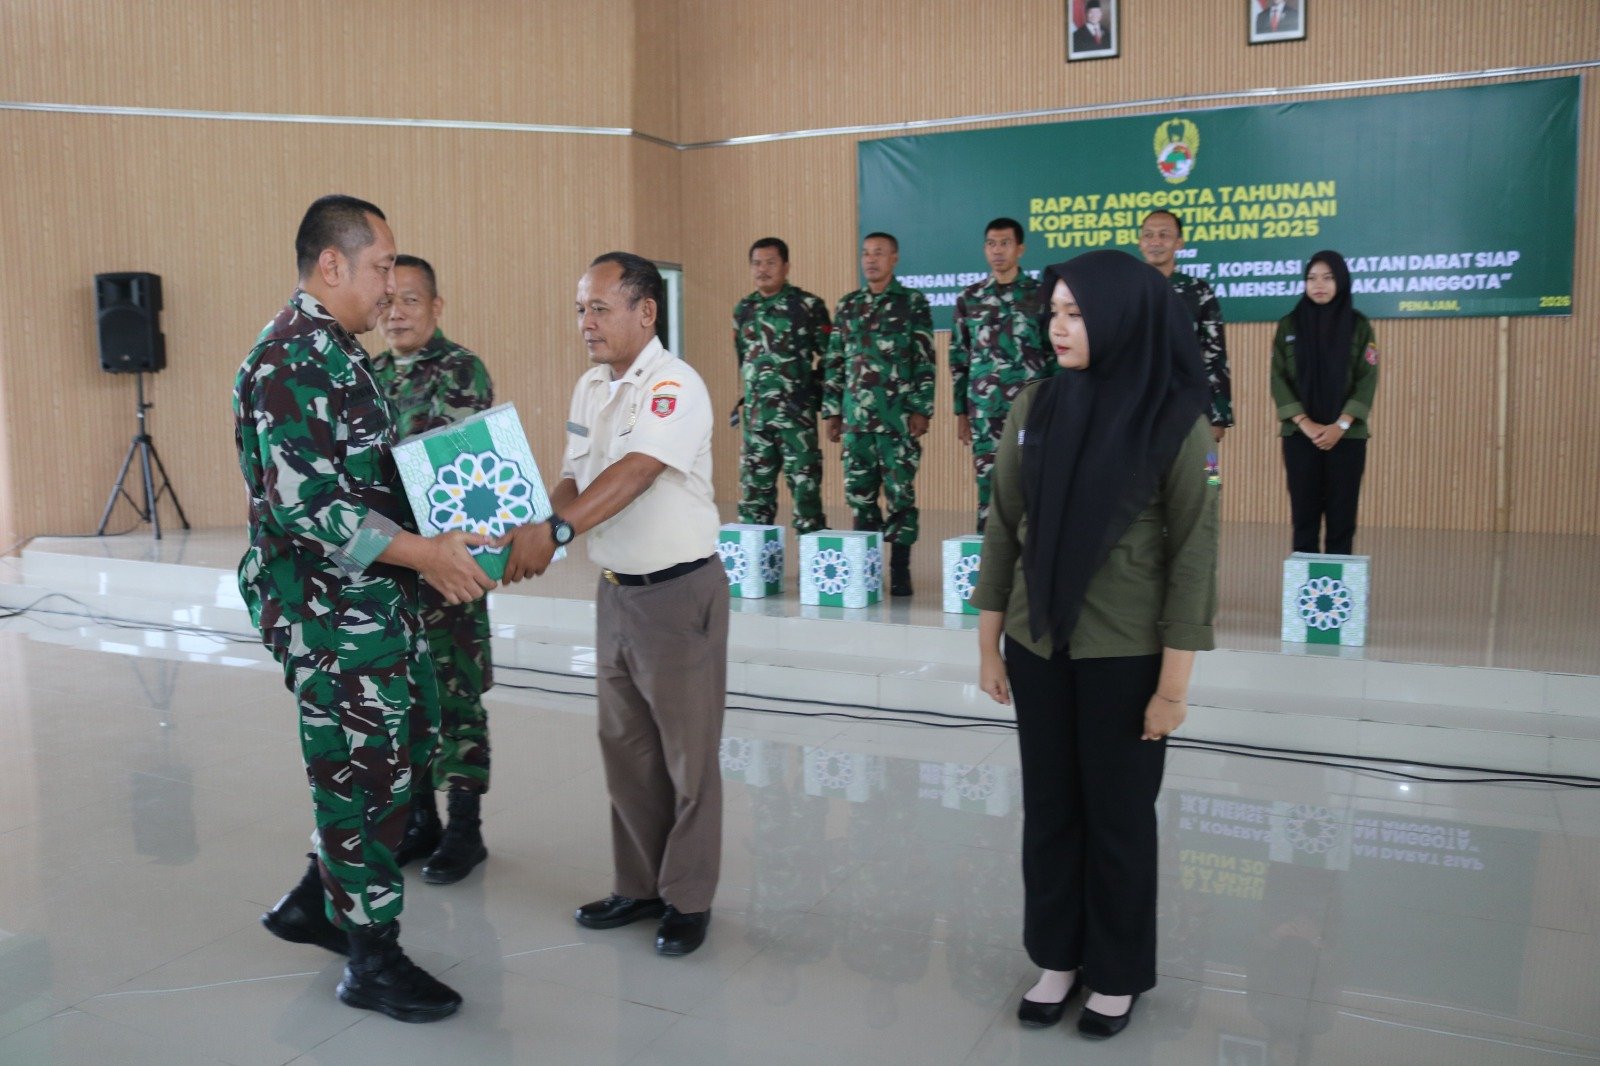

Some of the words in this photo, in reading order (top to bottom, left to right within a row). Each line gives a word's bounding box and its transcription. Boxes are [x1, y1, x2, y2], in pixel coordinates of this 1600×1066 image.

[1030, 195, 1100, 214] RAPAT
[1104, 187, 1216, 210] ANGGOTA
[1218, 180, 1336, 204] TAHUNAN
[1029, 210, 1133, 232] KOPERASI
[1137, 205, 1236, 227] KTIKA
[1239, 200, 1337, 222] MADANI
[1044, 230, 1113, 249] TUTUP
[1182, 223, 1260, 242] TAHUN
[1262, 218, 1320, 239] 2025
[1218, 259, 1302, 278] KOPERASI
[1408, 252, 1474, 271] DARAT
[1475, 250, 1521, 268] SIAP
